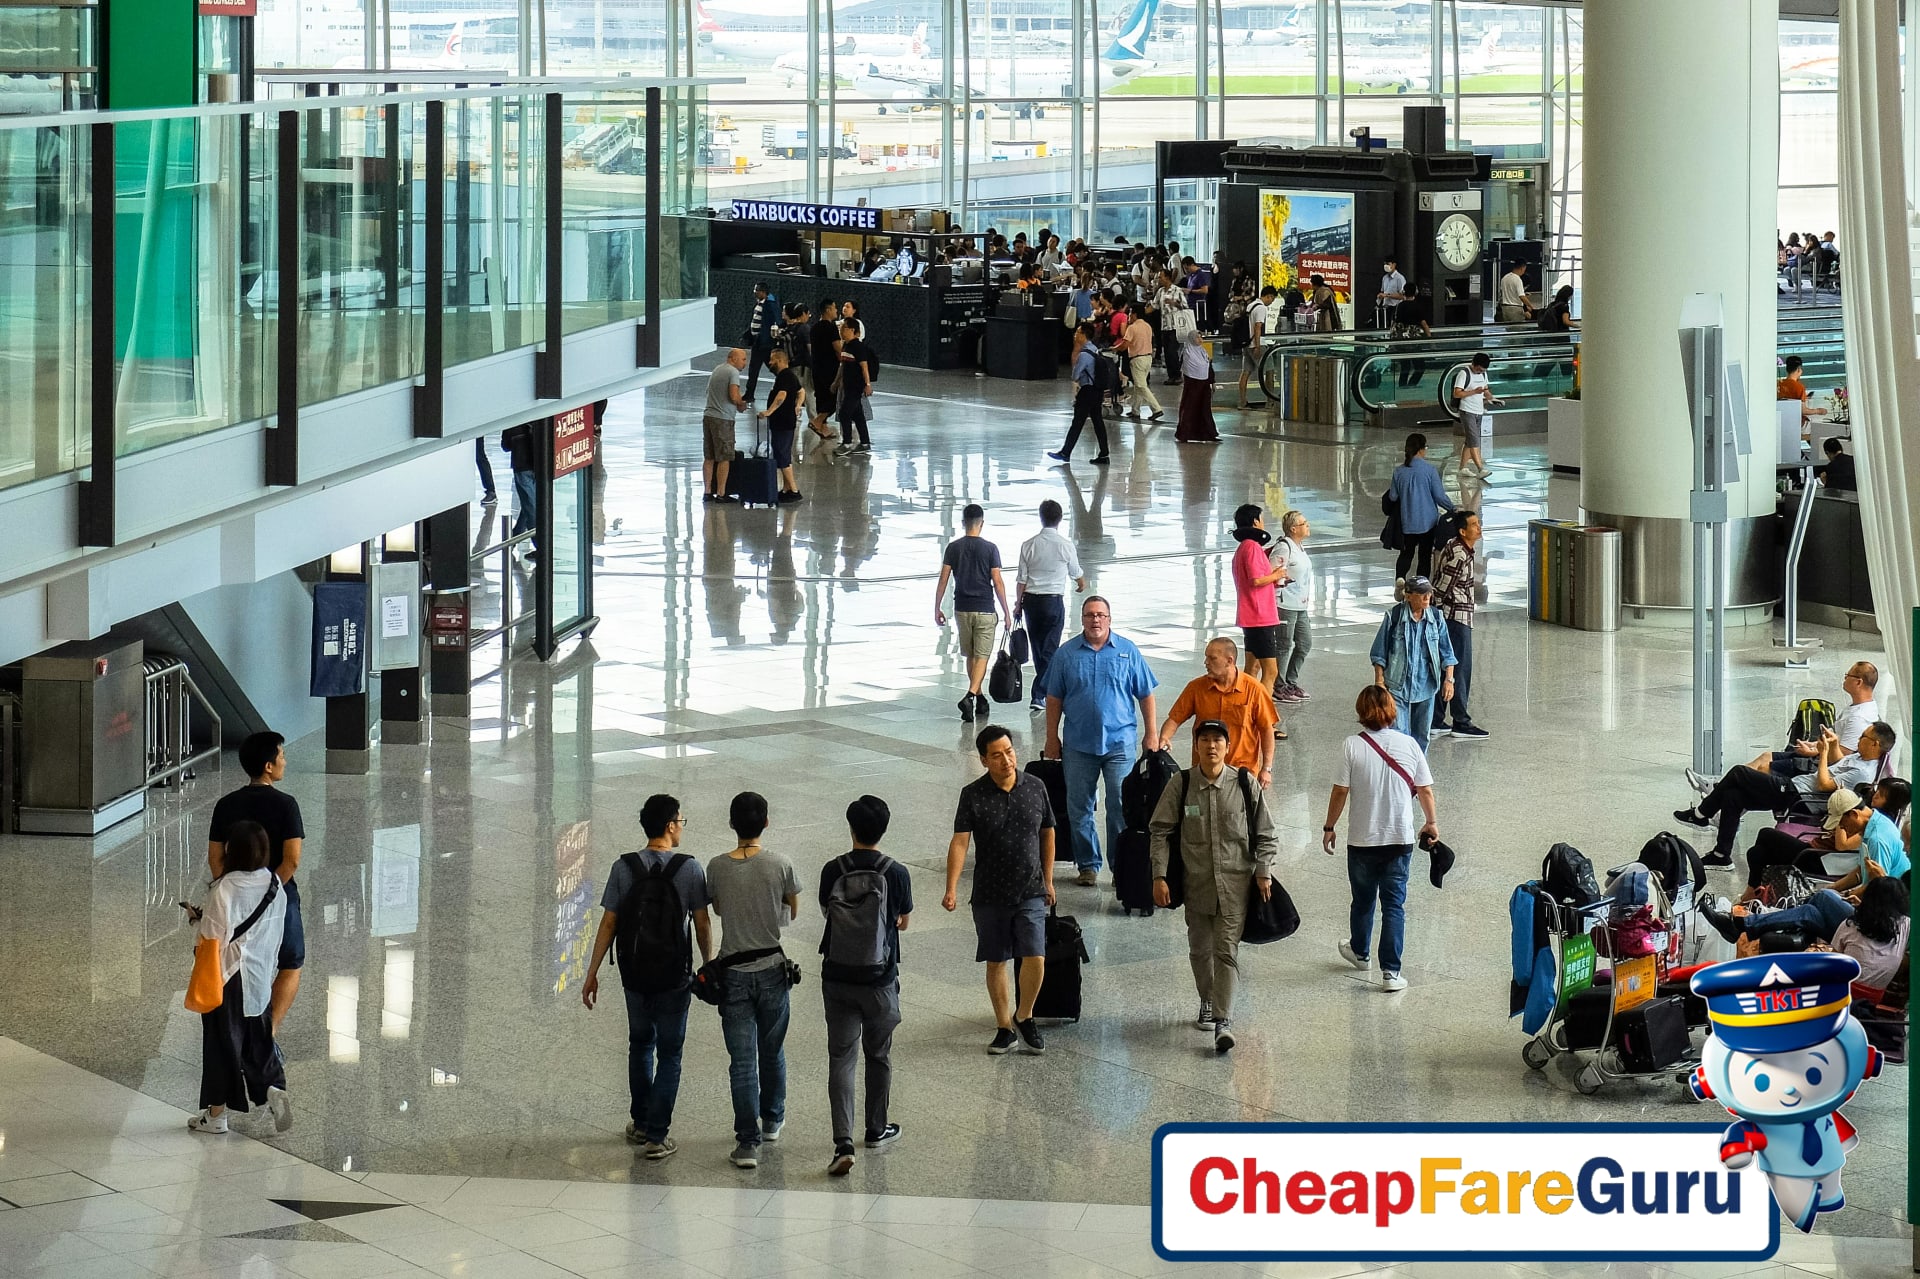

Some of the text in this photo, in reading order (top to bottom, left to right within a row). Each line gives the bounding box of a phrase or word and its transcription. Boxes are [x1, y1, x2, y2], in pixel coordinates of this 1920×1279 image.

[1491, 170, 1506, 179] EXIT
[732, 201, 876, 228] STARBUCKS COFFEE
